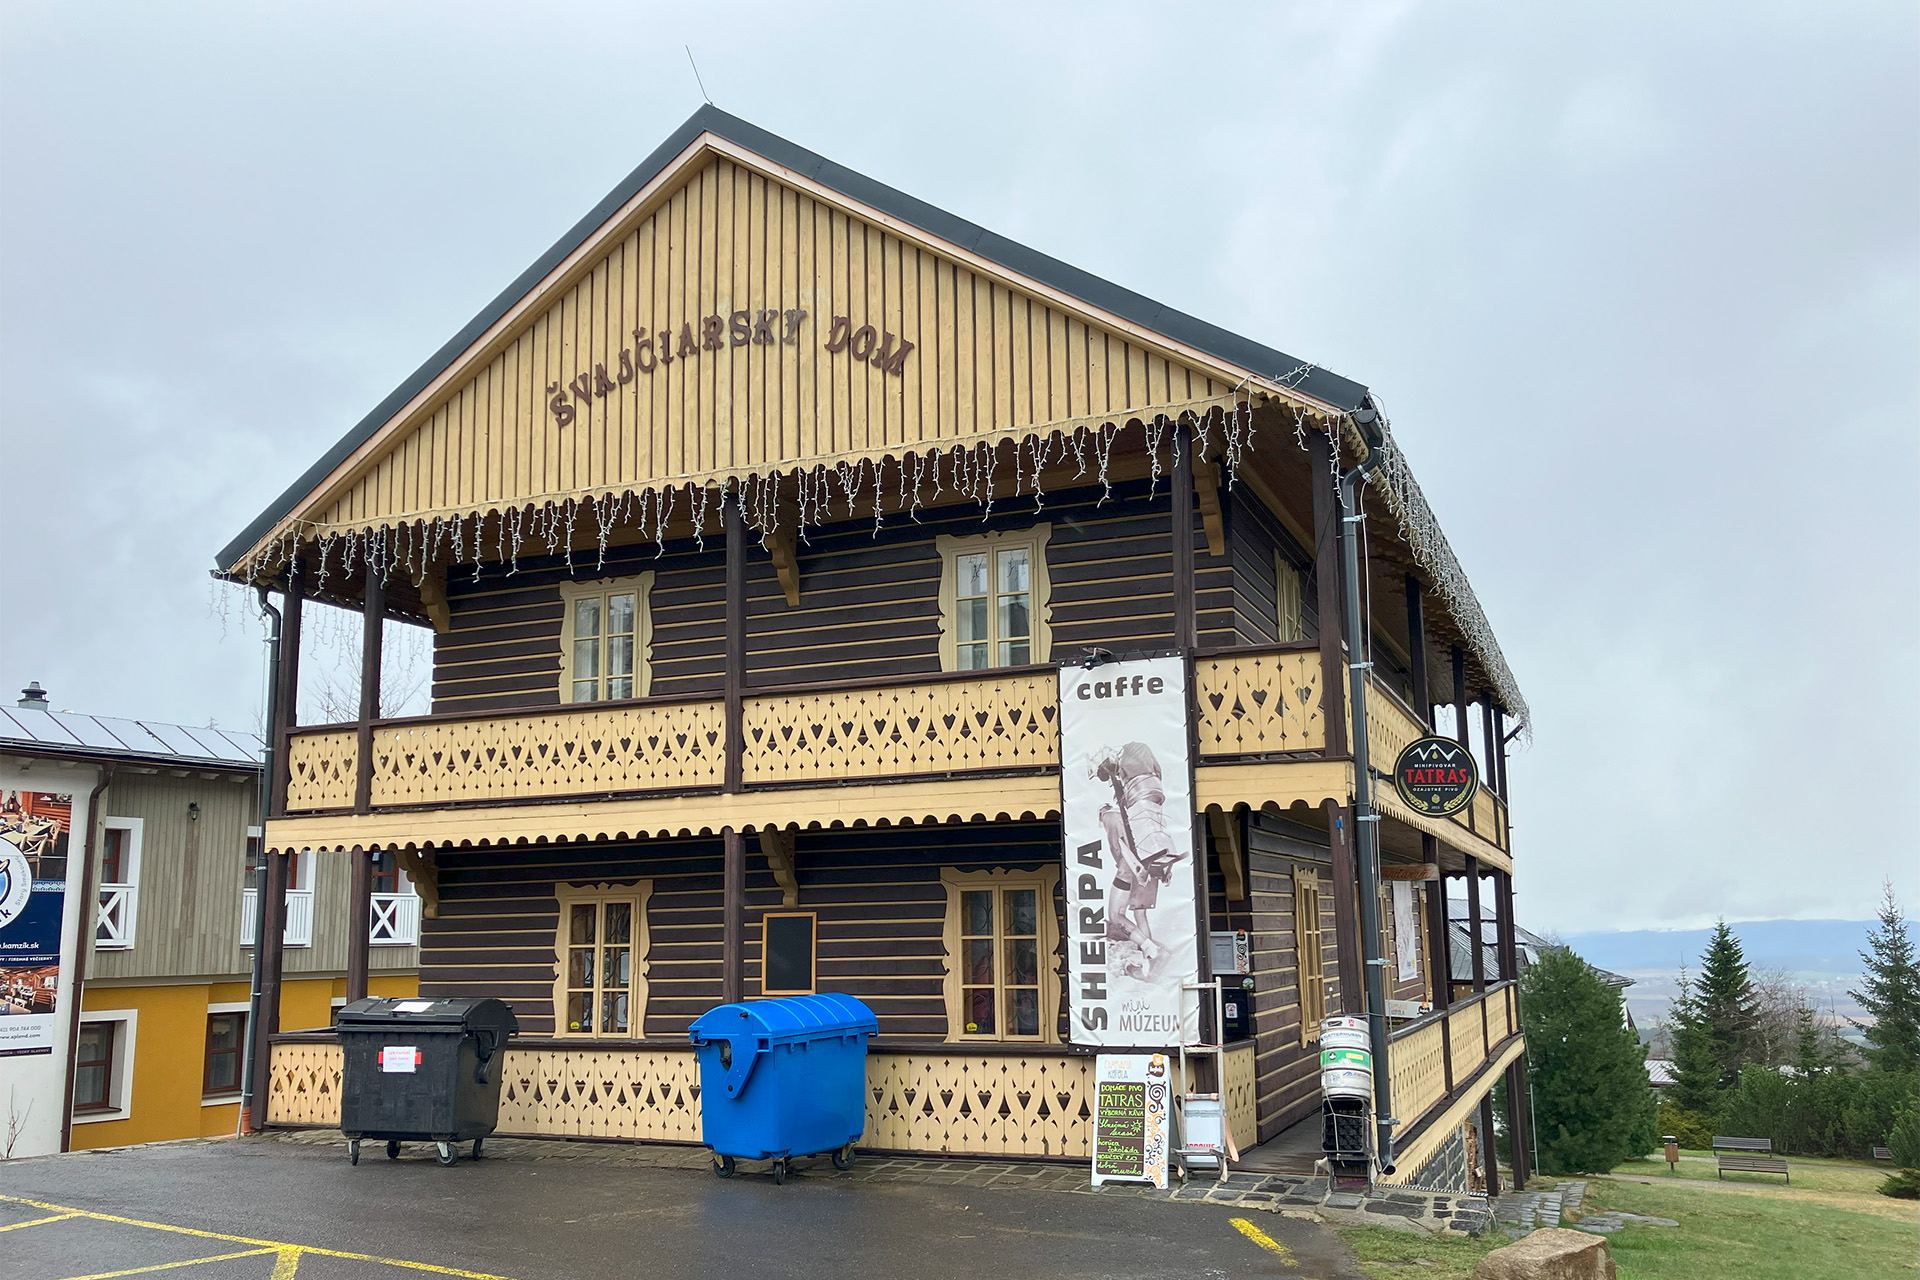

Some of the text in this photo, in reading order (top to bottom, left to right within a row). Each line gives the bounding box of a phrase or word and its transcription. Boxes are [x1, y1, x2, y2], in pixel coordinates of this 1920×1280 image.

[546, 308, 915, 428] ŠVAJČIARSKY DOM
[1076, 674, 1165, 700] caffe
[1405, 768, 1467, 784] TATRAS
[1076, 837, 1109, 1032] SHERPA
[1121, 997, 1151, 1013] mini
[1128, 1084, 1143, 1092] PIVO
[1099, 1094, 1143, 1107] TATRAS
